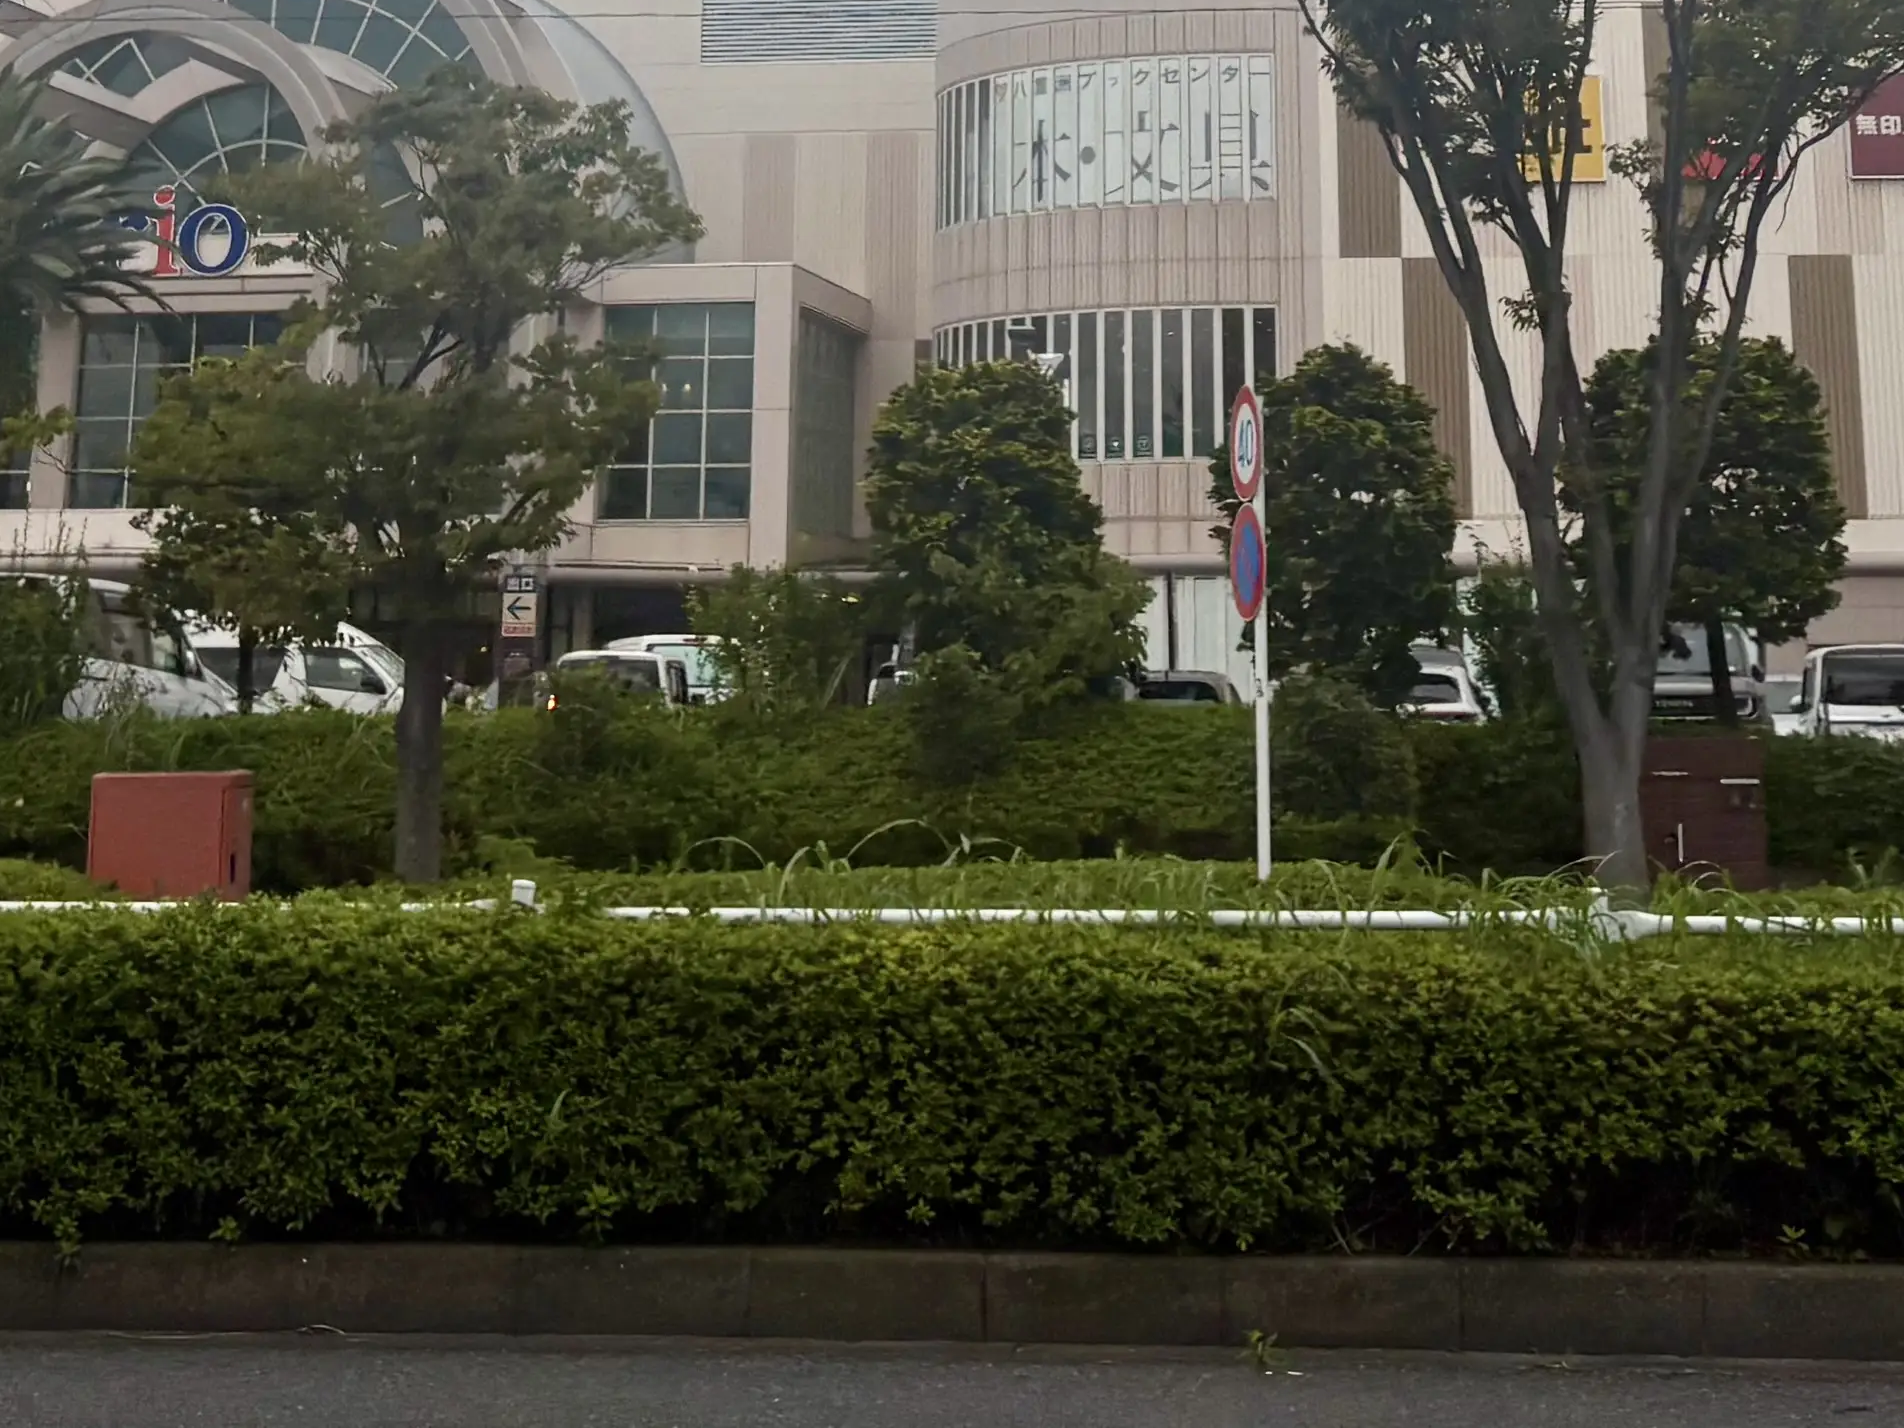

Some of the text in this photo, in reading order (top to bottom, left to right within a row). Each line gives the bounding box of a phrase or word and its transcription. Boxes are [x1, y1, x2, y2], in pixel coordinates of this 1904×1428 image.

[1013, 110, 1270, 202] 本・文具
[1238, 419, 1254, 467] 40
